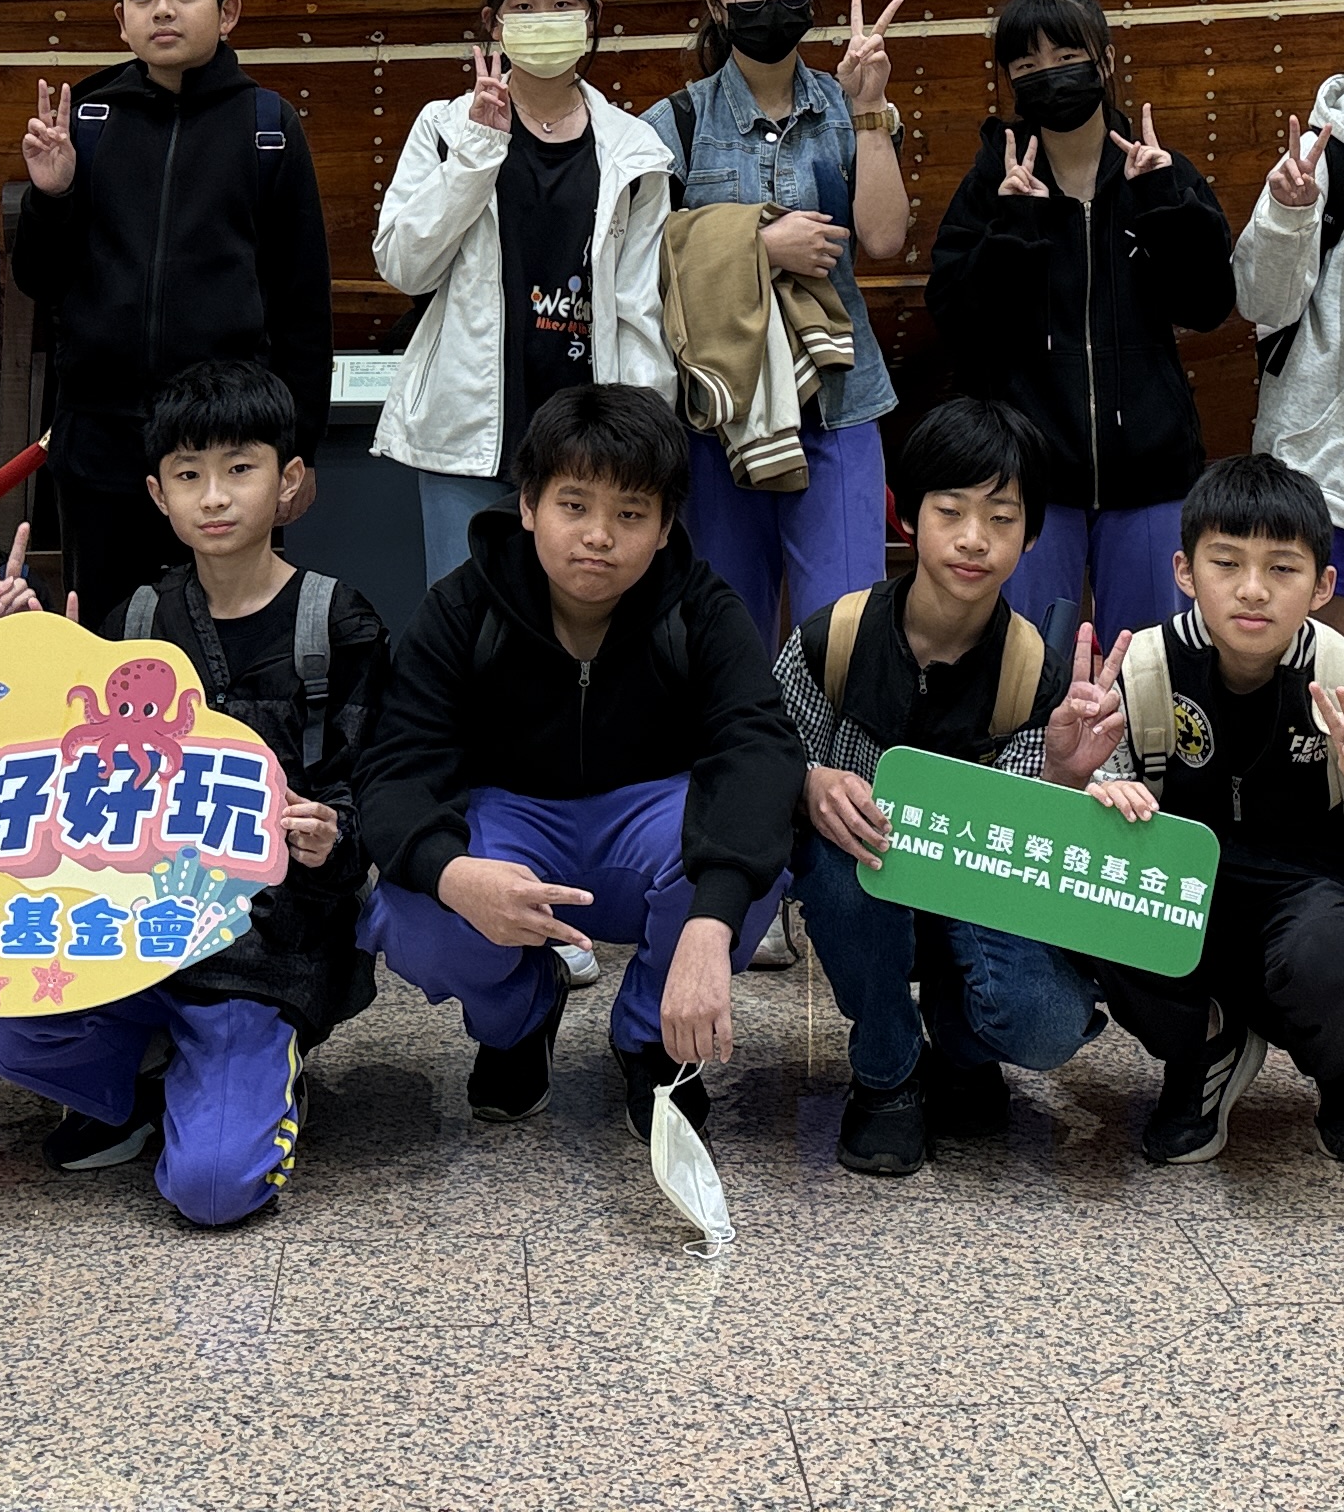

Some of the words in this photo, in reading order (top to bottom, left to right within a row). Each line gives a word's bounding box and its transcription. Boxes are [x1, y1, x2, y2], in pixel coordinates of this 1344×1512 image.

[887, 831, 945, 861] HANG
[952, 846, 1051, 890] YUNG-FA
[1058, 875, 1205, 931] FOUNDATION
